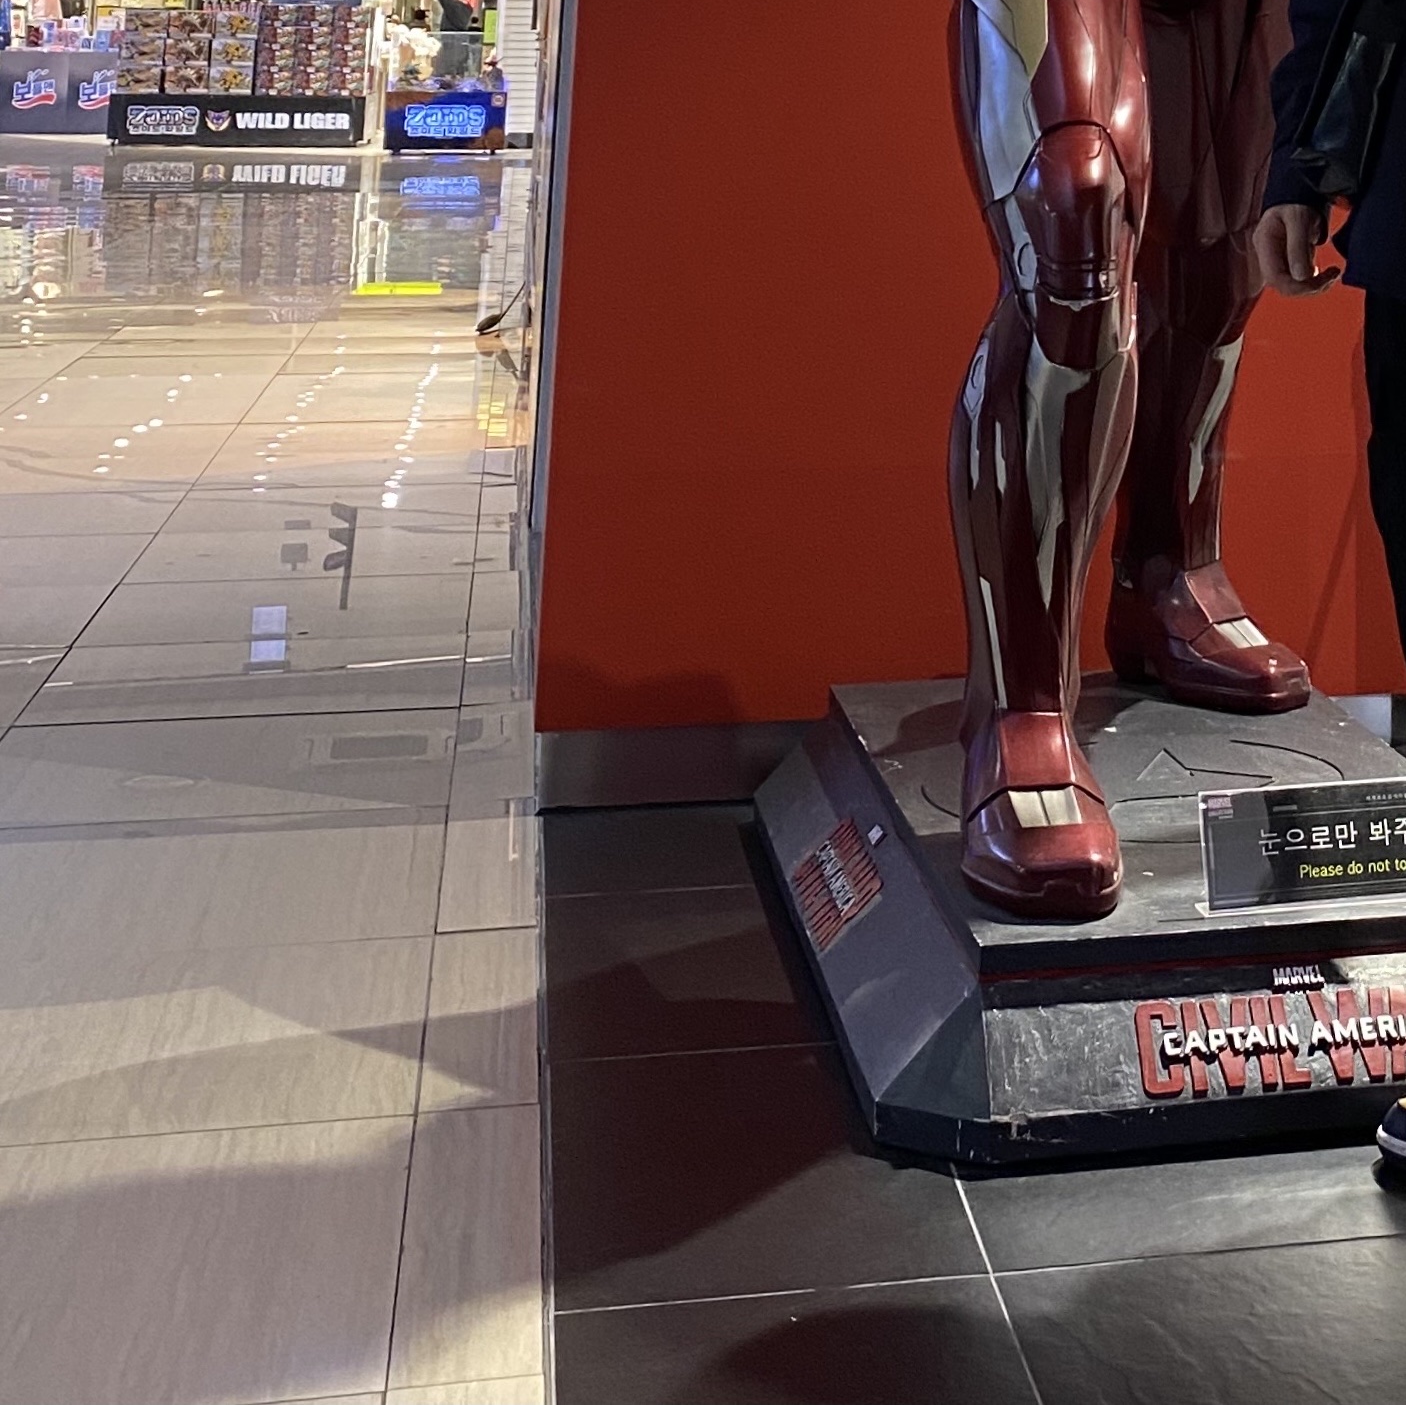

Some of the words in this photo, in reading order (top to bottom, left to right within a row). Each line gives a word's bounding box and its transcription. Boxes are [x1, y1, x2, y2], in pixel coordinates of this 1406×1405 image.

[235, 112, 290, 130] WILD
[293, 112, 350, 131] LIGER
[1258, 821, 1358, 856] 눈으로만
[1299, 863, 1344, 879] Please
[1347, 860, 1364, 876] do
[1368, 858, 1391, 874] not
[1272, 964, 1325, 986] MARVEL
[1134, 994, 1312, 1098] CIVIL
[1162, 1024, 1300, 1057] CAPTAIN
